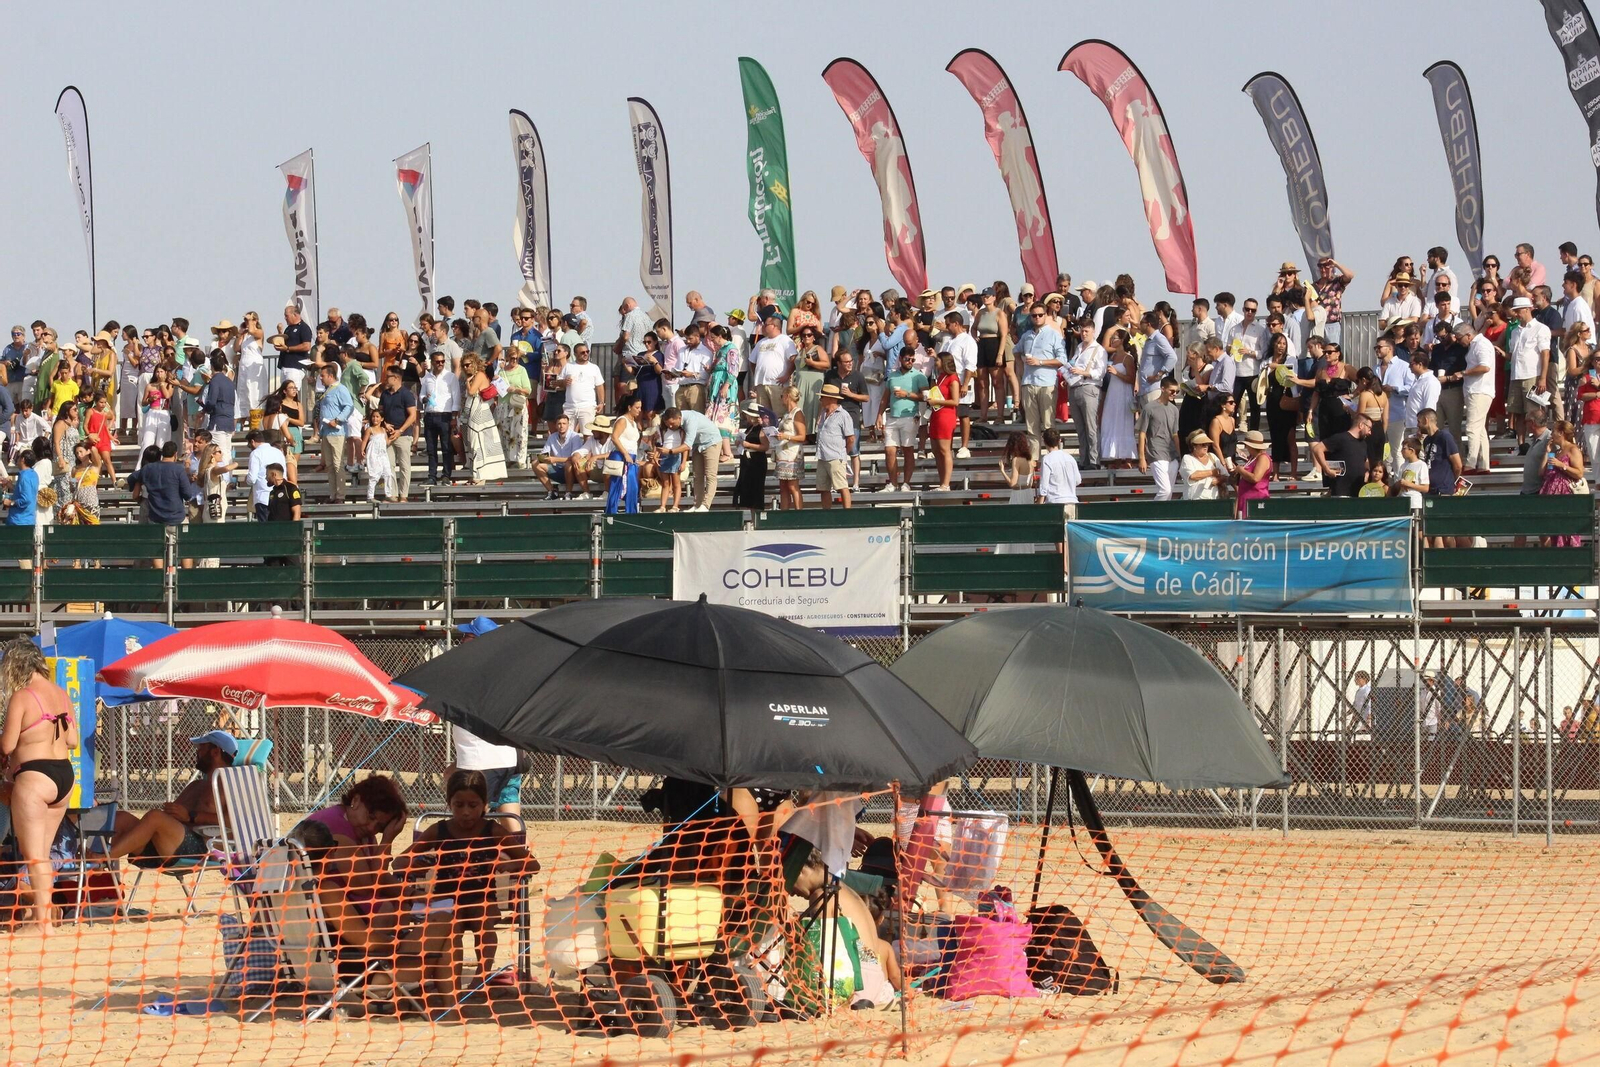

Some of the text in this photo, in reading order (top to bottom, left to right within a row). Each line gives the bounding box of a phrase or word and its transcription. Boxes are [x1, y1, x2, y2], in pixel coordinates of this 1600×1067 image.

[1157, 537, 1276, 563] Diputación
[1300, 540, 1406, 561] DEPORTES
[722, 567, 849, 589] COHEBU
[1156, 571, 1253, 596] de Cádiz
[738, 595, 829, 607] Correduría de Seguros
[768, 703, 828, 715] CAPERLAN
